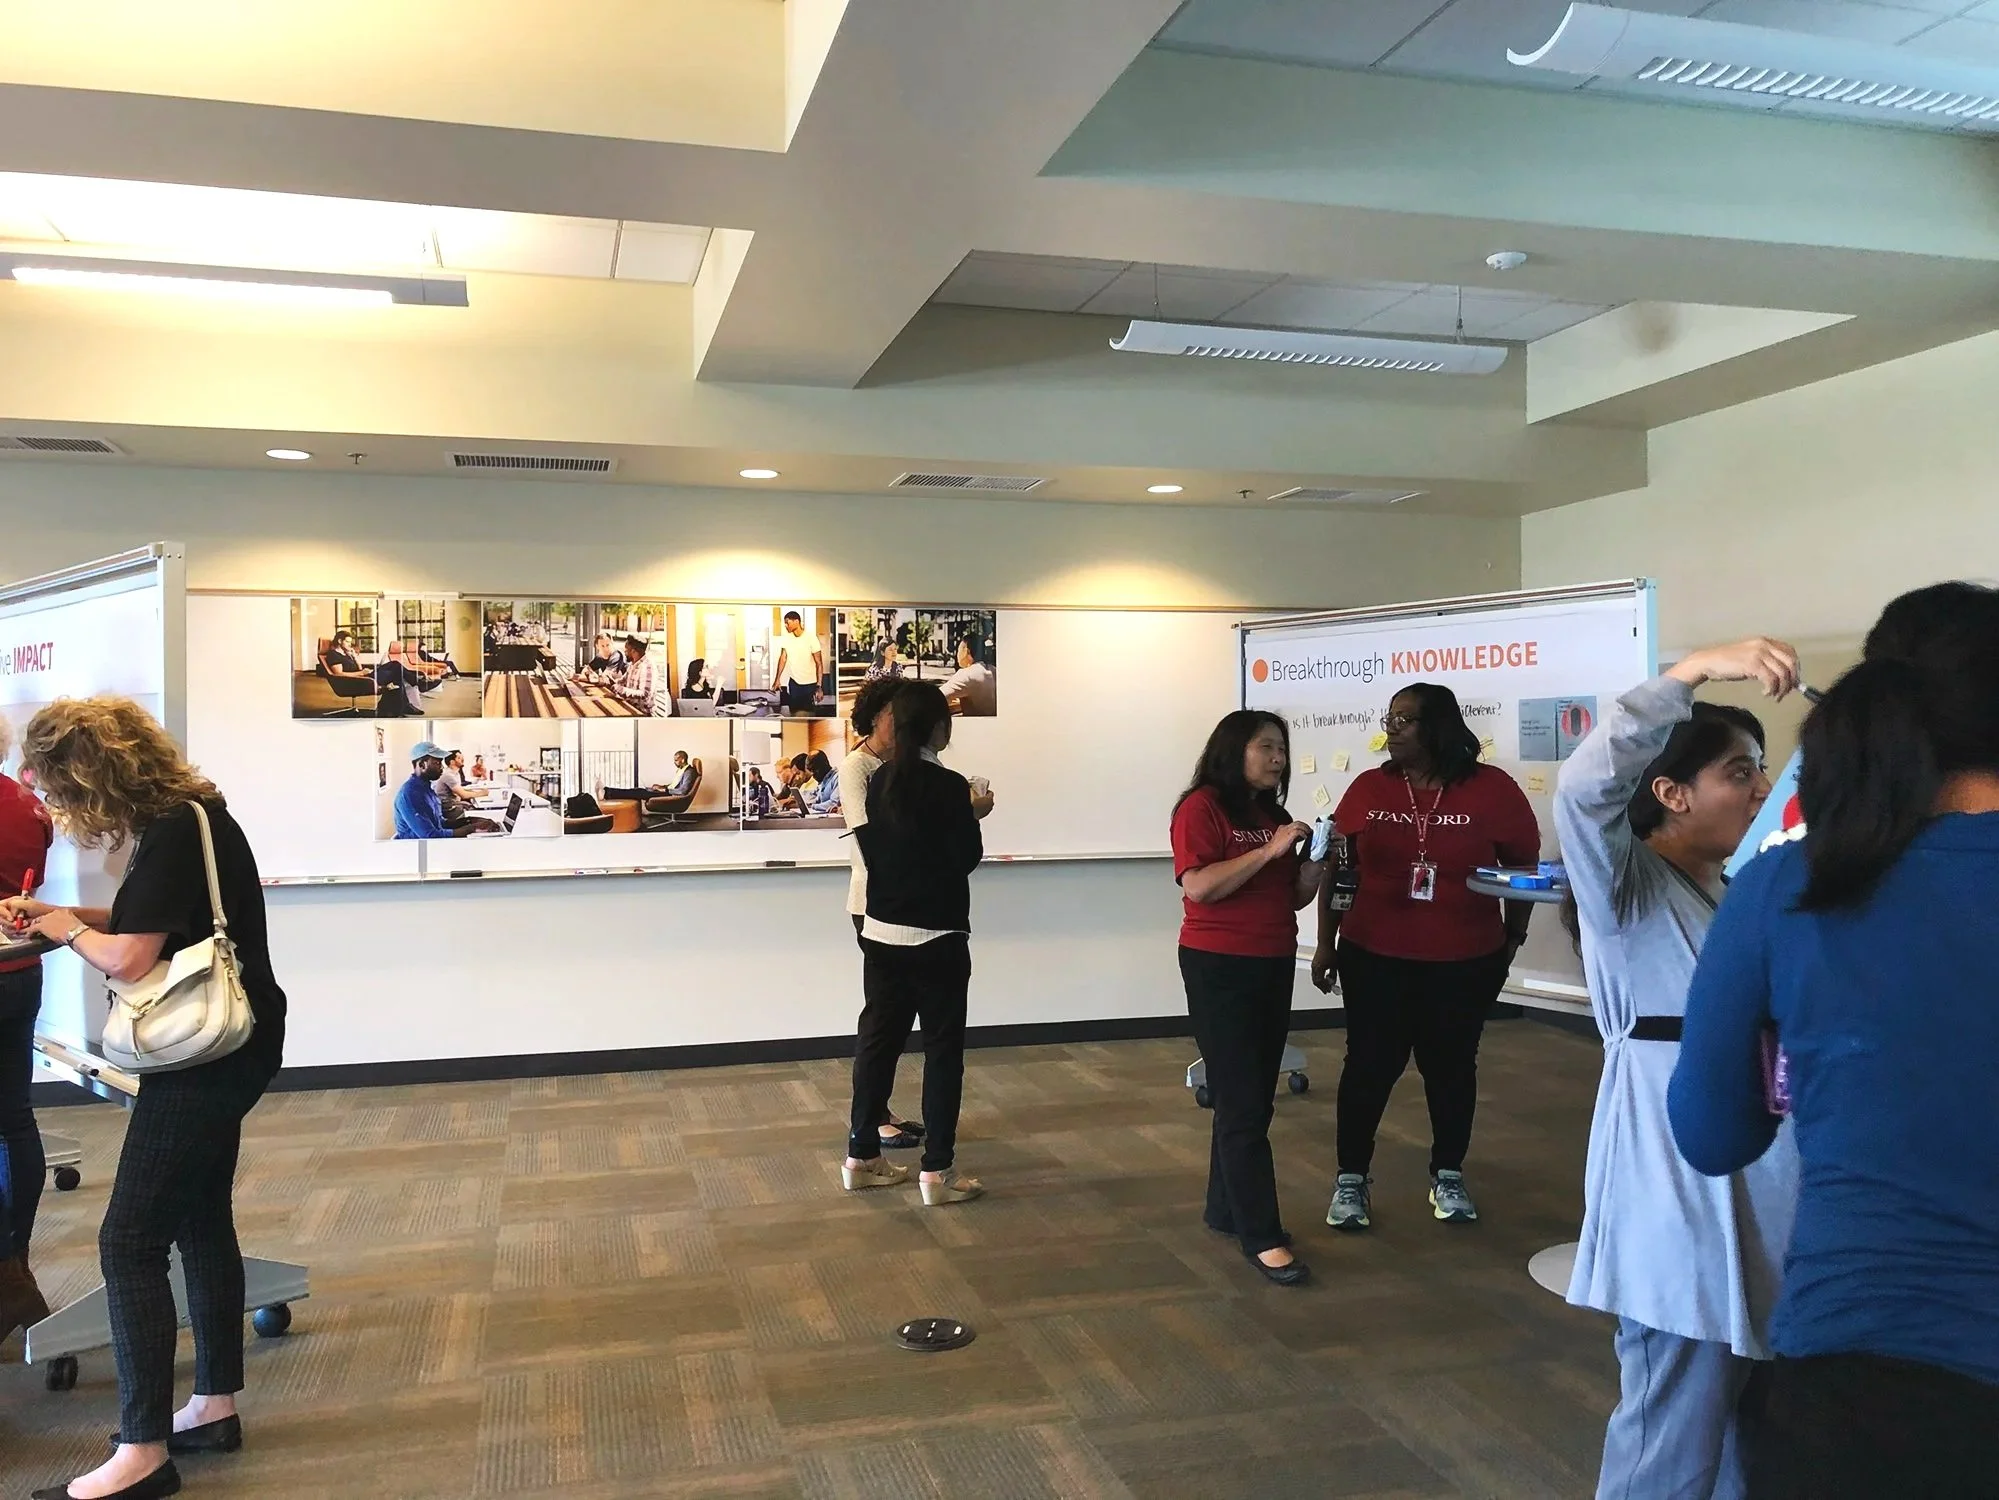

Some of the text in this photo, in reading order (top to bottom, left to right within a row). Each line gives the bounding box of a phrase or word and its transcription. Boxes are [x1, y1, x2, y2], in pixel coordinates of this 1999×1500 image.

[13, 642, 54, 674] IMPACT
[1272, 641, 1538, 683] Breakthrough KNOWLEDGE
[1232, 829, 1274, 843] STANF
